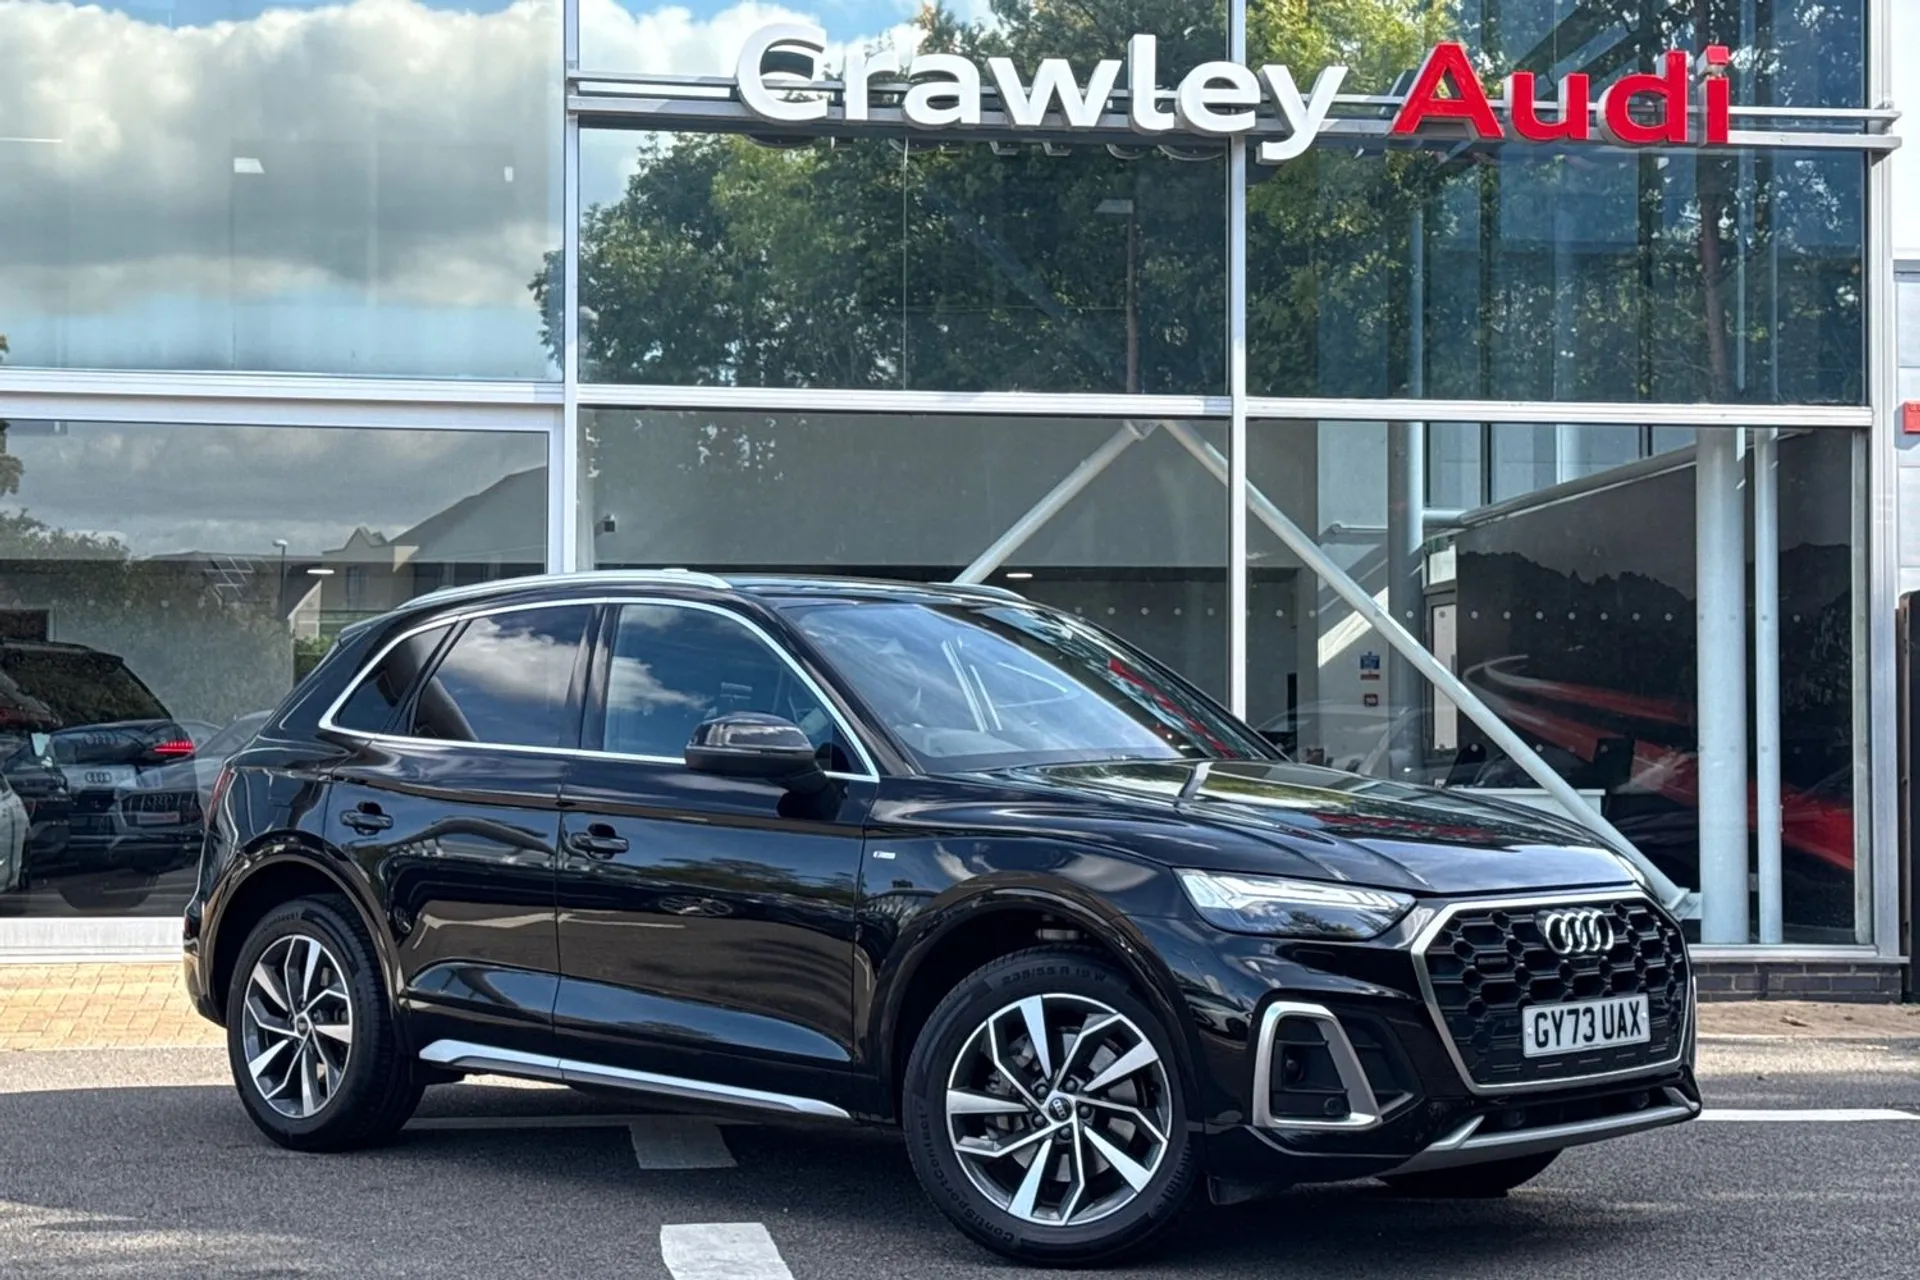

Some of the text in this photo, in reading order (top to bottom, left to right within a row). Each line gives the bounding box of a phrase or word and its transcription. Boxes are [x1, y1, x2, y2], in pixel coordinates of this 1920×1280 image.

[736, 22, 1730, 164] Crawley Audi
[1534, 1000, 1641, 1048] GY73 UAX
